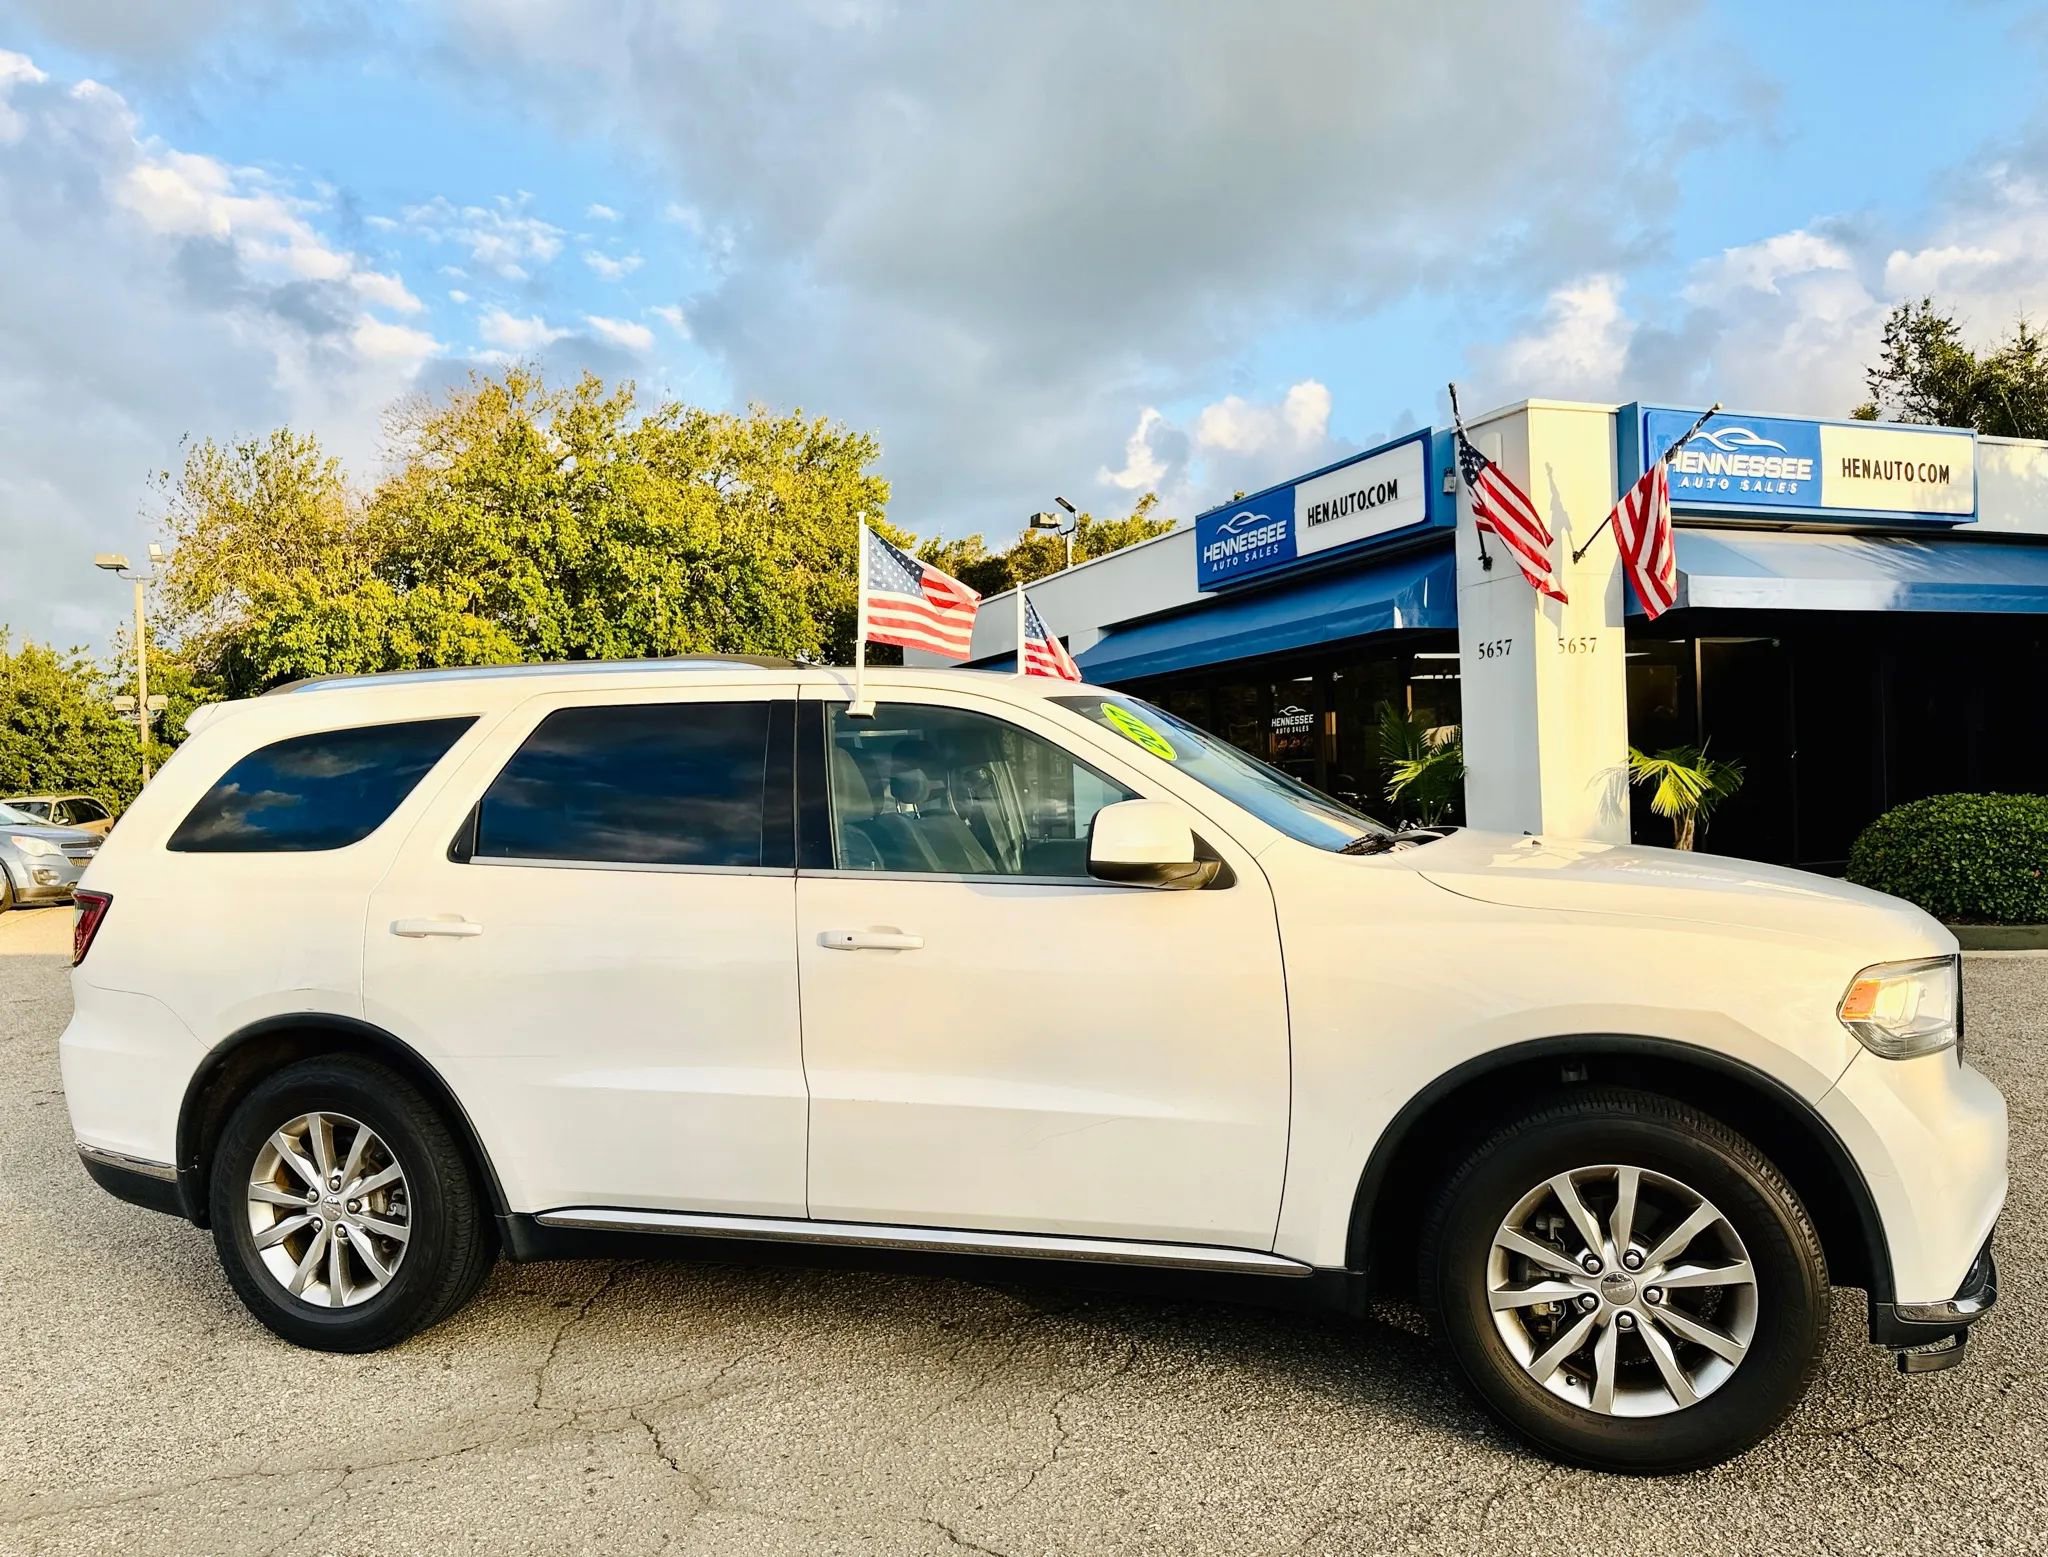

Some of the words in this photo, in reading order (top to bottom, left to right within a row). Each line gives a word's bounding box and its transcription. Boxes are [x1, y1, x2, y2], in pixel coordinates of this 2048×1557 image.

[1679, 476, 1730, 490] AUTO
[1740, 480, 1799, 494] SALES
[1307, 478, 1398, 528] HENAUTO.COM
[1203, 520, 1287, 563] HENNESSEE
[1212, 557, 1238, 572] AUTO
[1244, 544, 1279, 562] SALES
[1478, 638, 1513, 660] 5657
[1557, 637, 1597, 655] 5657
[1271, 713, 1315, 728] HENNESSEE
[1275, 727, 1291, 735] AUTO
